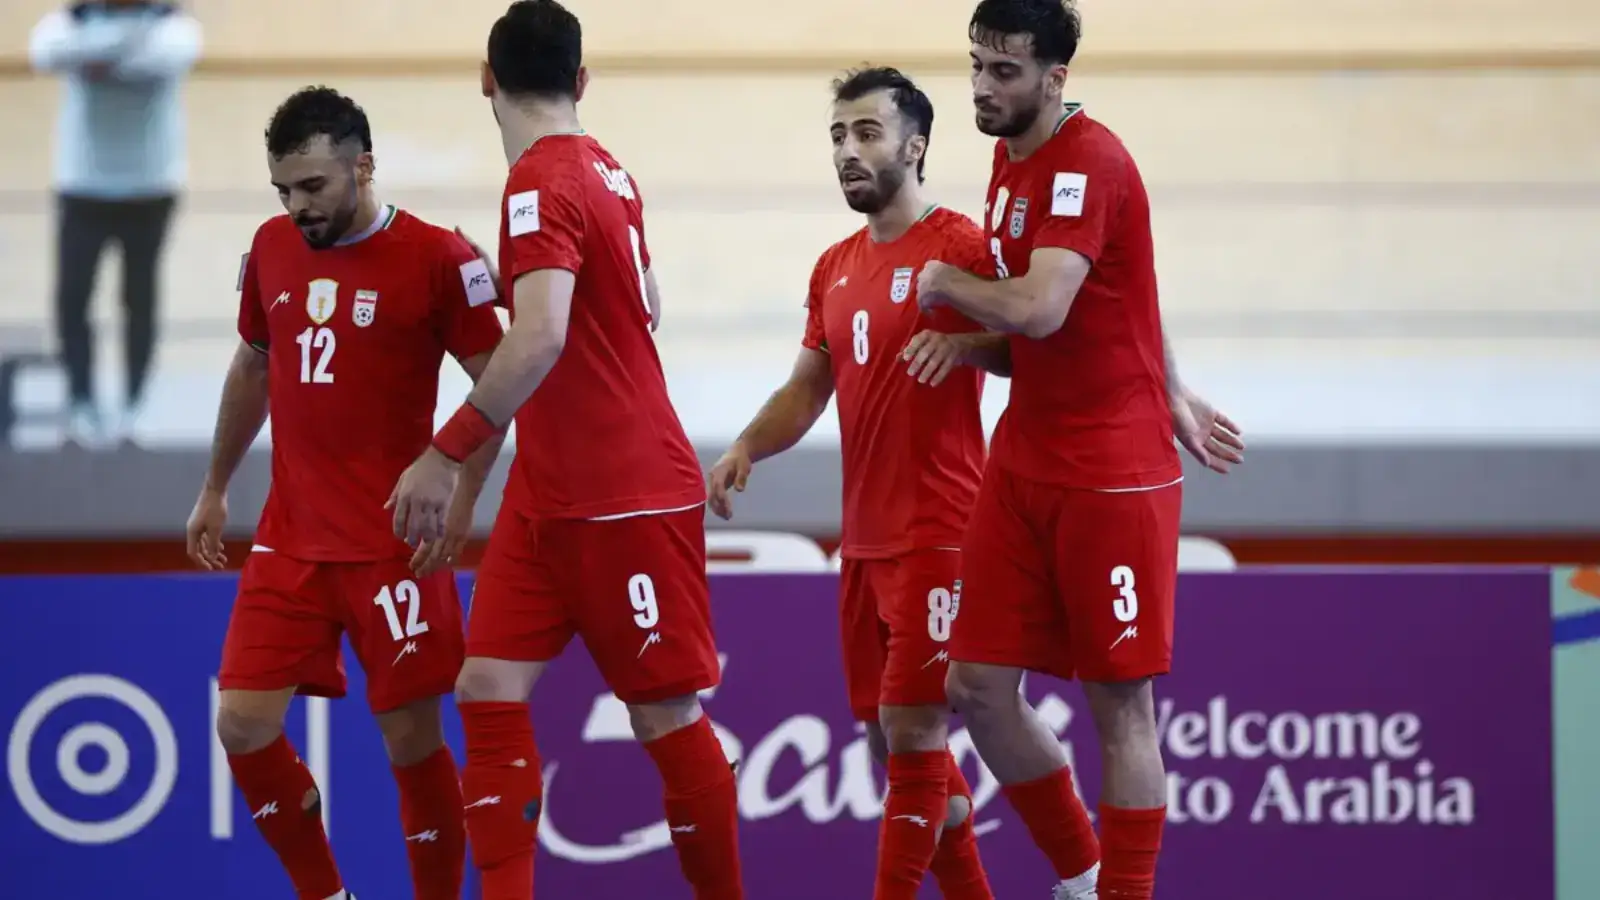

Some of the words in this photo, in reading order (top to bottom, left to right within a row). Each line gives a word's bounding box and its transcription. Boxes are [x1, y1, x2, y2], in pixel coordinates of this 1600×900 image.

[1056, 187, 1081, 199] AFC
[296, 327, 336, 384] 12
[852, 309, 869, 365] 8
[373, 579, 428, 640] 12
[628, 573, 659, 629] 9
[927, 587, 951, 642] 8
[1110, 565, 1138, 622] 3
[1166, 771, 1234, 824] to
[1249, 759, 1476, 826] Arabia
